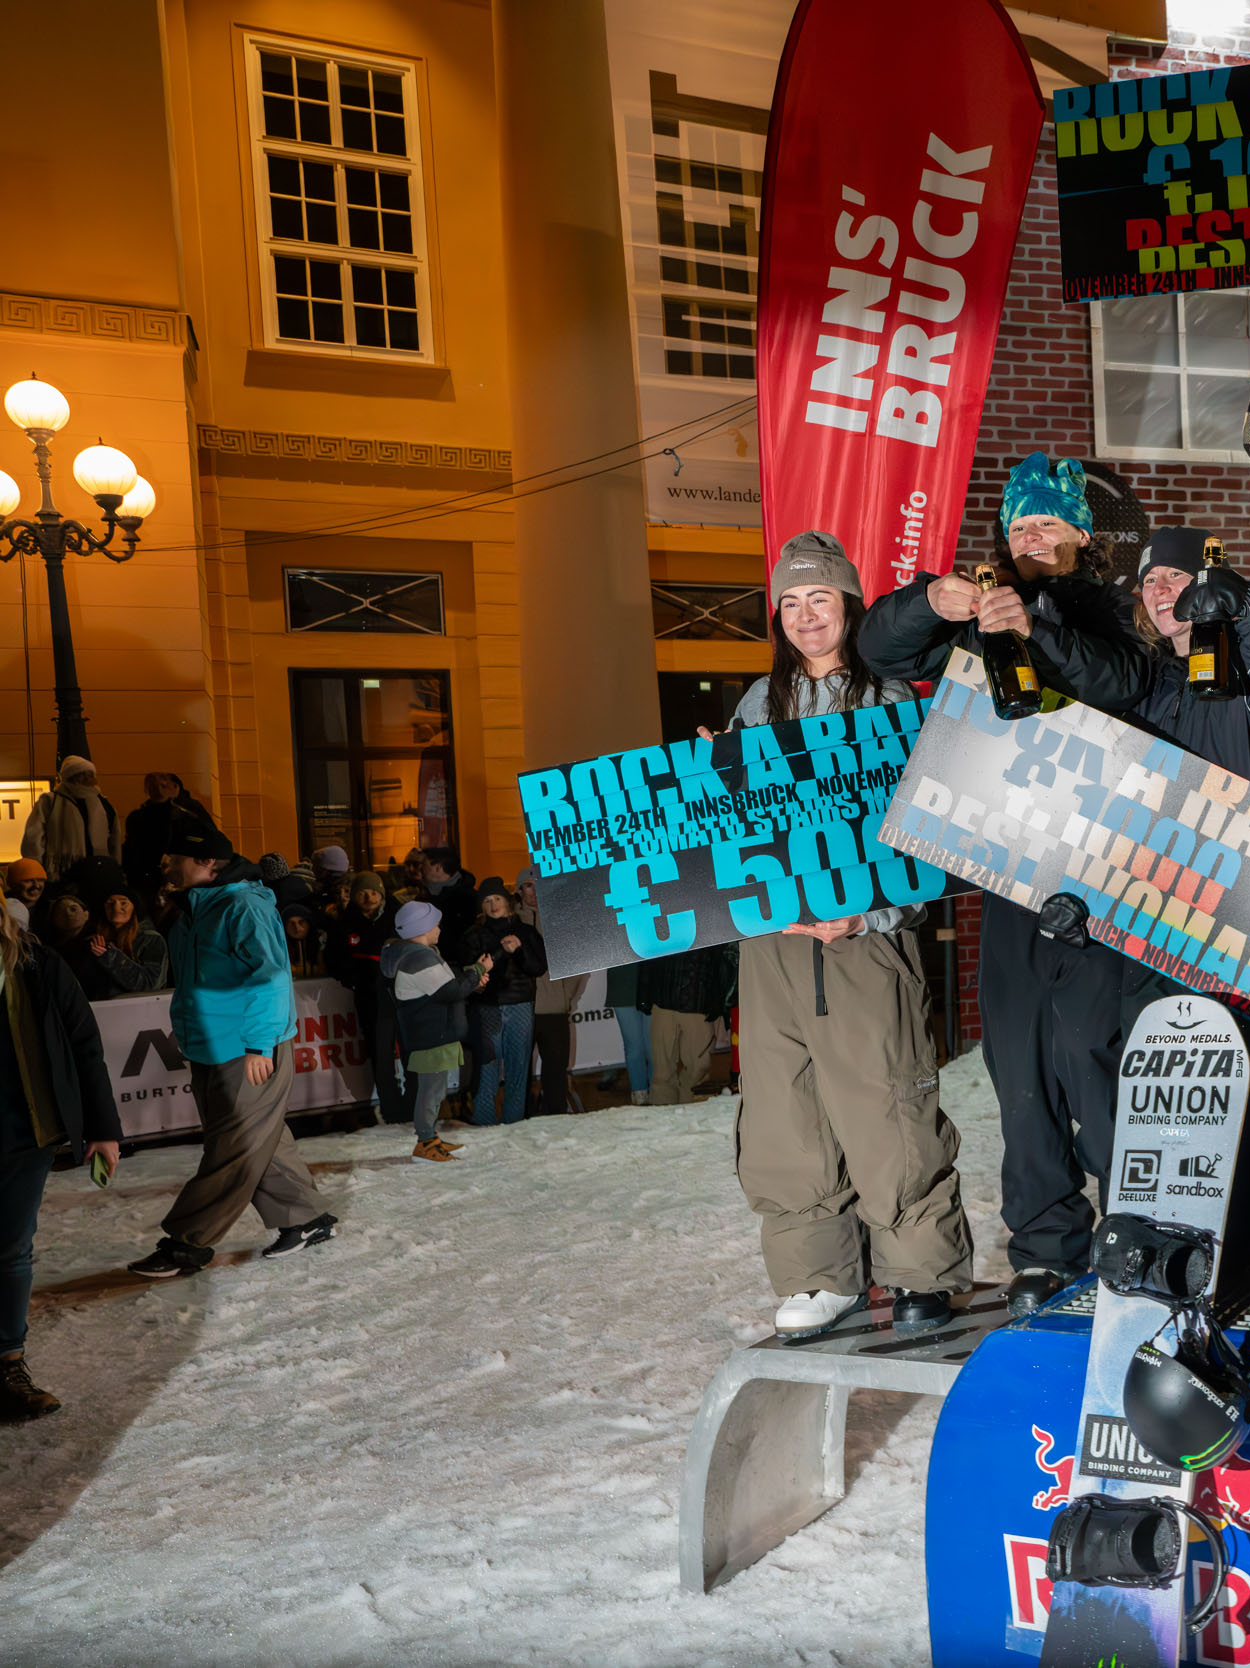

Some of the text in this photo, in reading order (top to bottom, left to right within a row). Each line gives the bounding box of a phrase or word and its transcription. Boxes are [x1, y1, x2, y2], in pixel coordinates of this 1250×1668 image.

[1053, 67, 1243, 159] ROCK
[804, 183, 900, 433] INNS'
[875, 131, 993, 448] BRUCK
[890, 490, 928, 591] ck.info
[518, 697, 933, 832] ROCK A RAI
[614, 806, 666, 835] 24TH
[684, 781, 800, 822] INNSBRUCK
[1115, 737, 1185, 812] A
[533, 838, 614, 878] BLUE
[613, 812, 745, 862] TOMATO
[746, 793, 861, 834] STAIRS
[901, 776, 1062, 887] BEST
[1059, 783, 1242, 916] 1000
[604, 815, 947, 959] € 500
[967, 860, 1016, 898] 24TH
[1141, 944, 1236, 999] NOVEMBER
[1145, 1034, 1232, 1044] BEYOND MEDALS.
[1128, 1115, 1227, 1126] BINDING COMPANY
[1130, 1085, 1230, 1114] UNION
[1118, 1193, 1157, 1202] DEELUXE
[1166, 1181, 1224, 1198] sandbox
[1088, 1462, 1171, 1478] BINDING COMPANY
